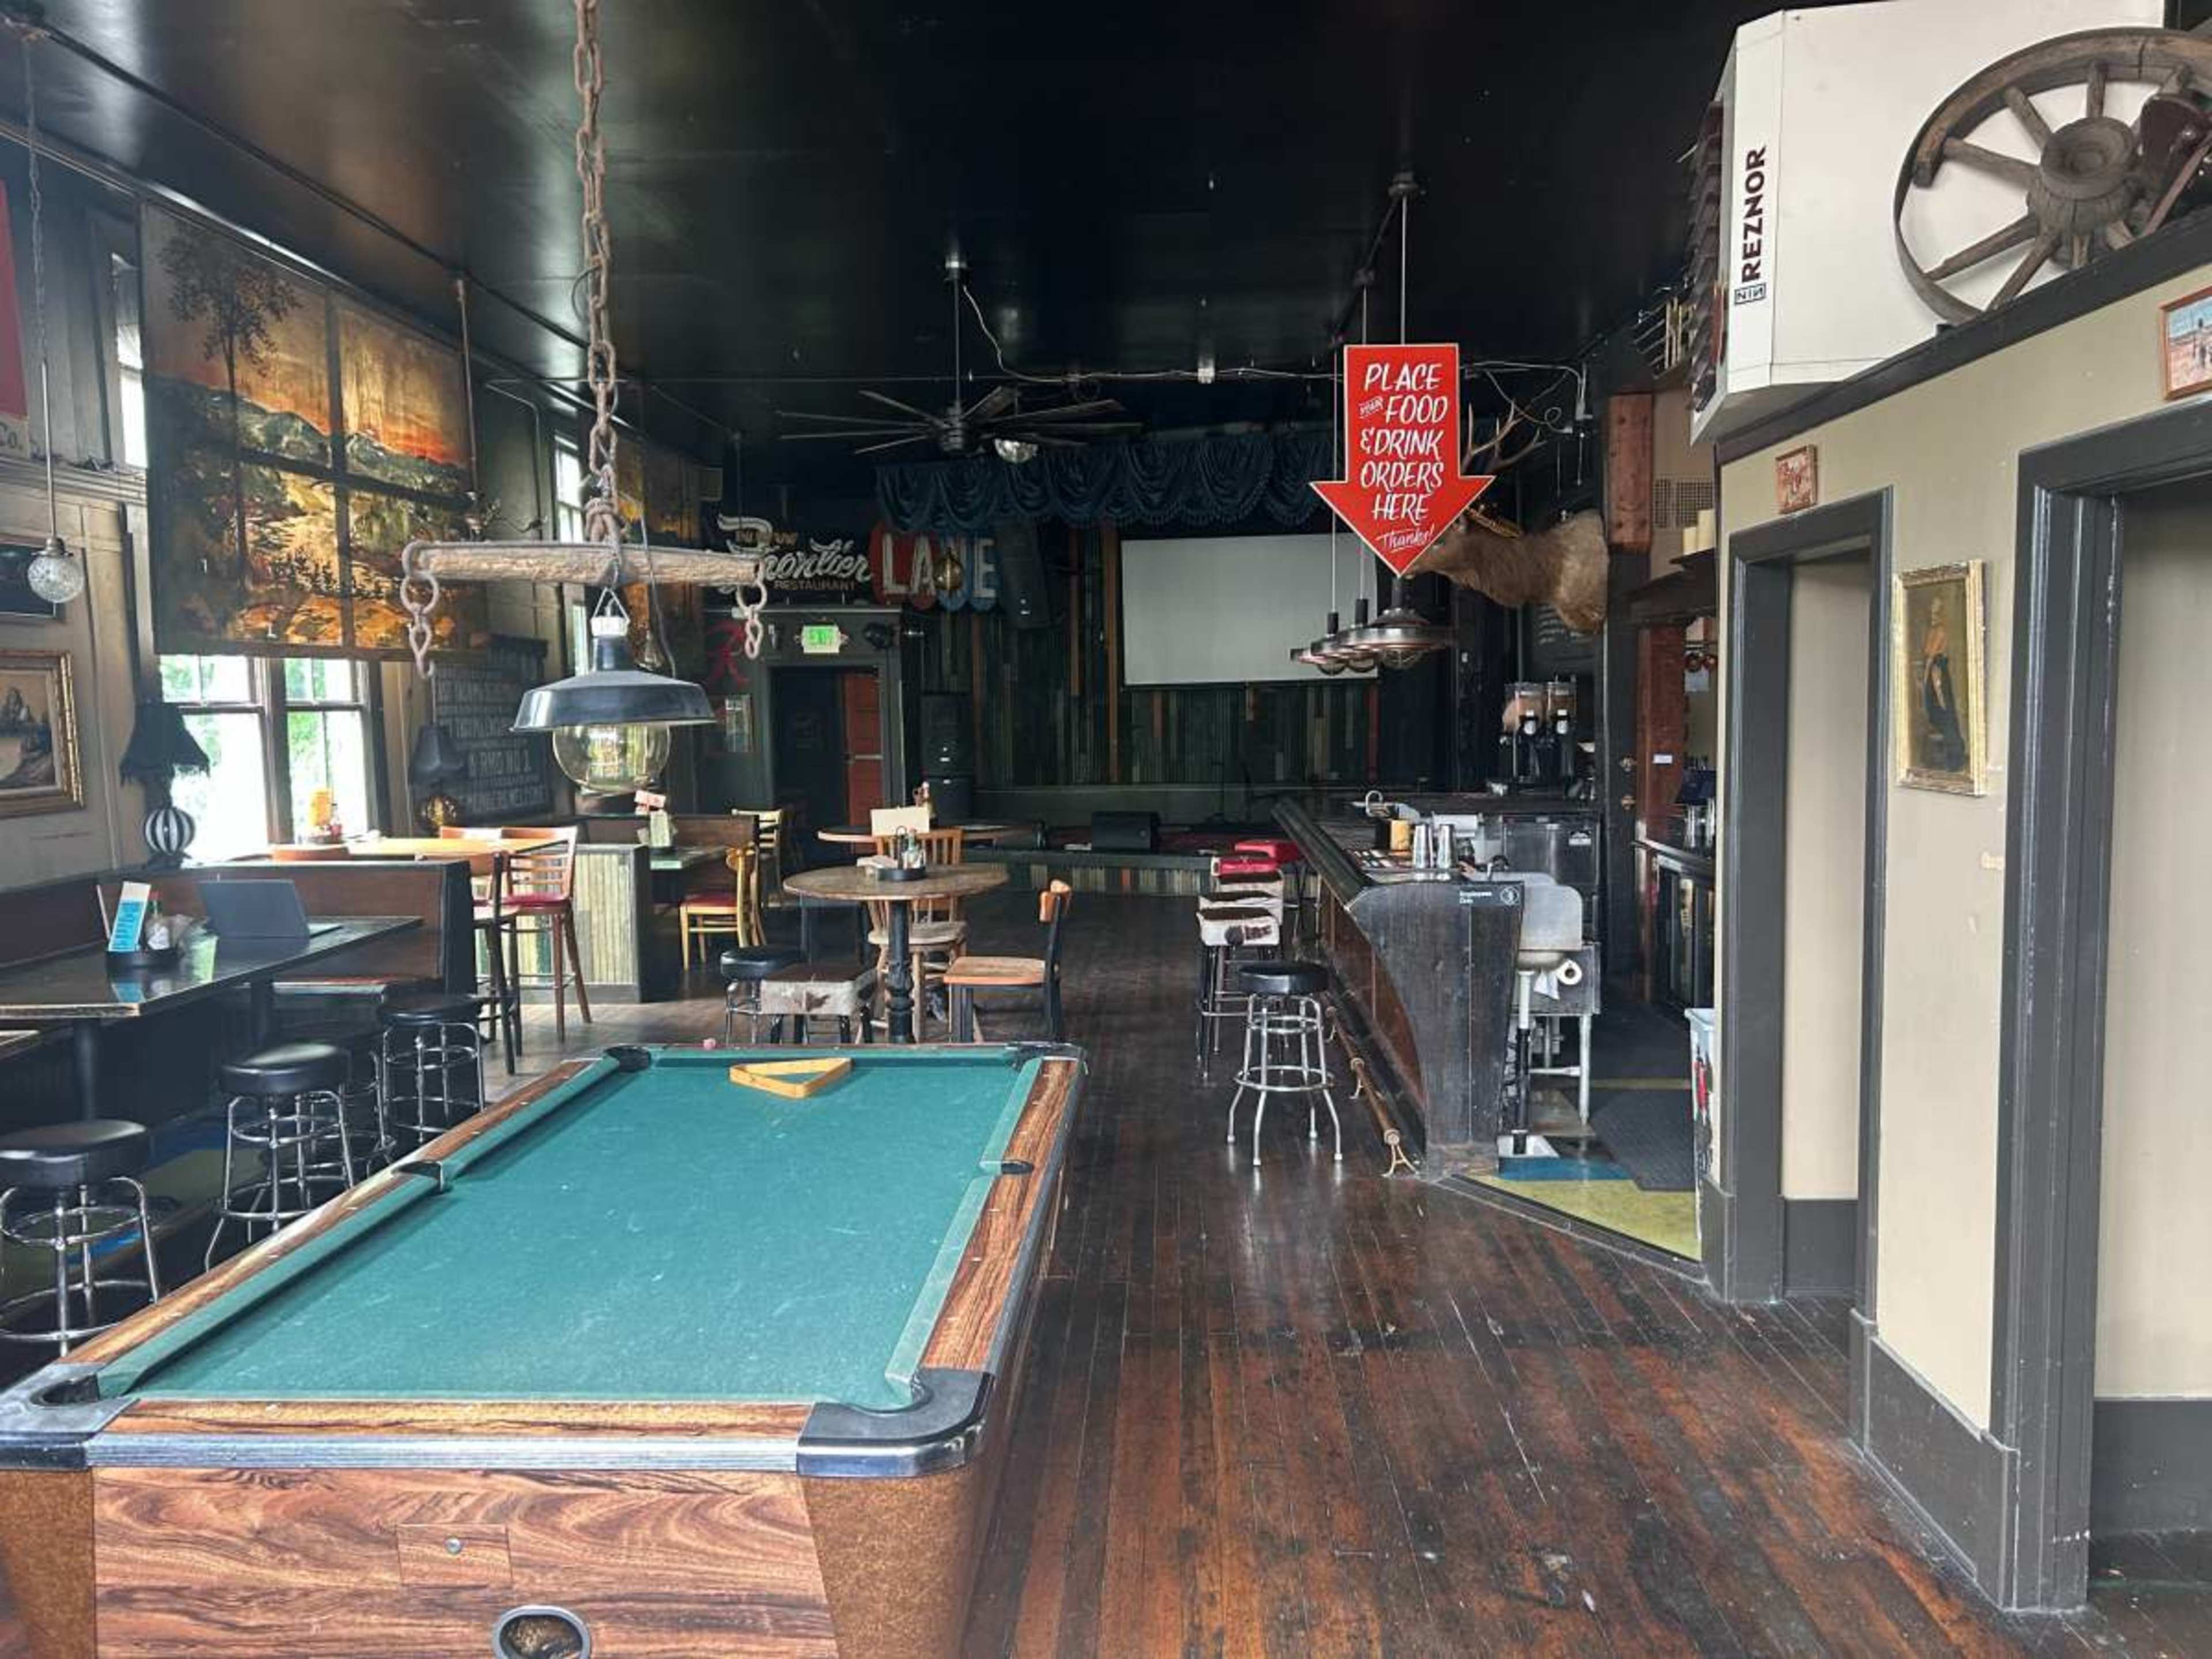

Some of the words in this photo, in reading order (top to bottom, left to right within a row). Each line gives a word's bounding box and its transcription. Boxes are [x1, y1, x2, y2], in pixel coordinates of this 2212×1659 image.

[1741, 145, 1767, 282] REZNOR
[1365, 363, 1441, 391] PLACE
[1385, 395, 1449, 424] FOOD
[1360, 461, 1444, 493] ORDERS
[1372, 494, 1431, 525] HERE
[774, 580, 856, 590] RESTAURANT
